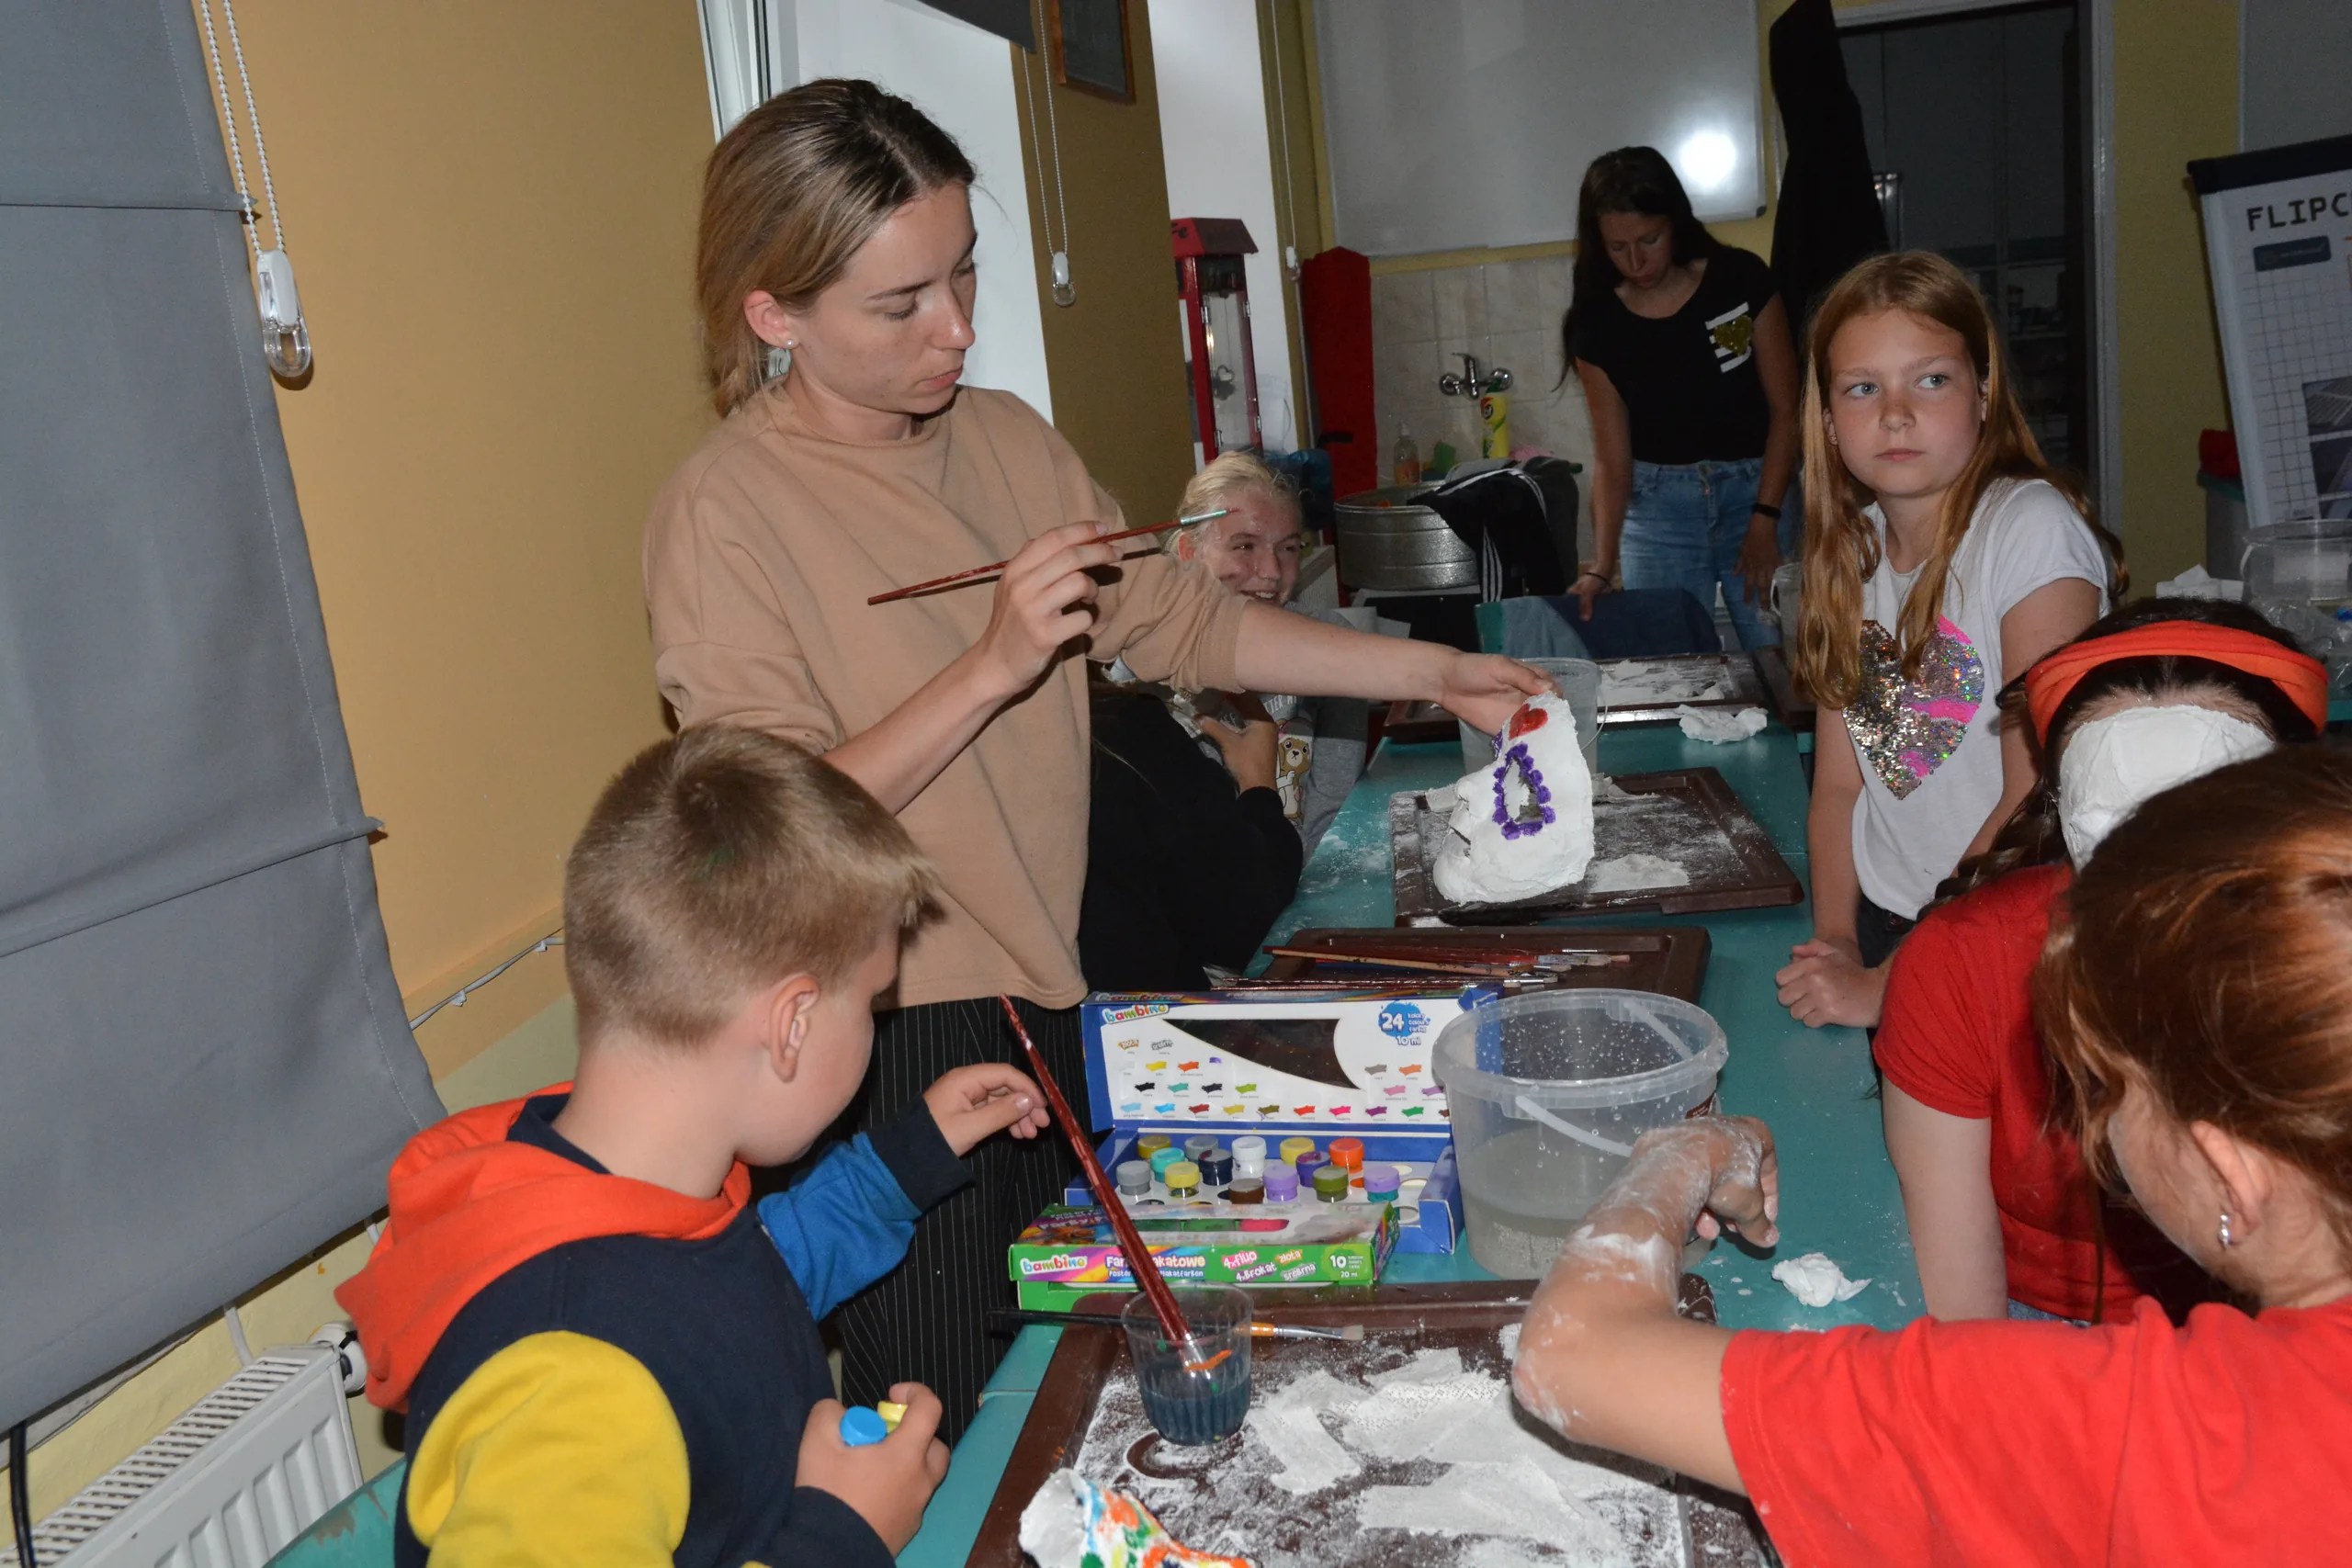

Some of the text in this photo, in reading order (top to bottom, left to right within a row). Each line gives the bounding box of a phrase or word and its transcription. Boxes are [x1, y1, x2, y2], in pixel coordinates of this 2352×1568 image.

[2246, 189, 2352, 231] FLIPC
[1104, 1004, 1167, 1022] bambino
[1381, 1012, 1405, 1032] 24
[1396, 1036, 1421, 1045] 10 ml
[1023, 1256, 1086, 1273] bambino
[1153, 1255, 1206, 1268] akatowe
[1329, 1255, 1348, 1269] 10
[1340, 1270, 1351, 1279] 20
